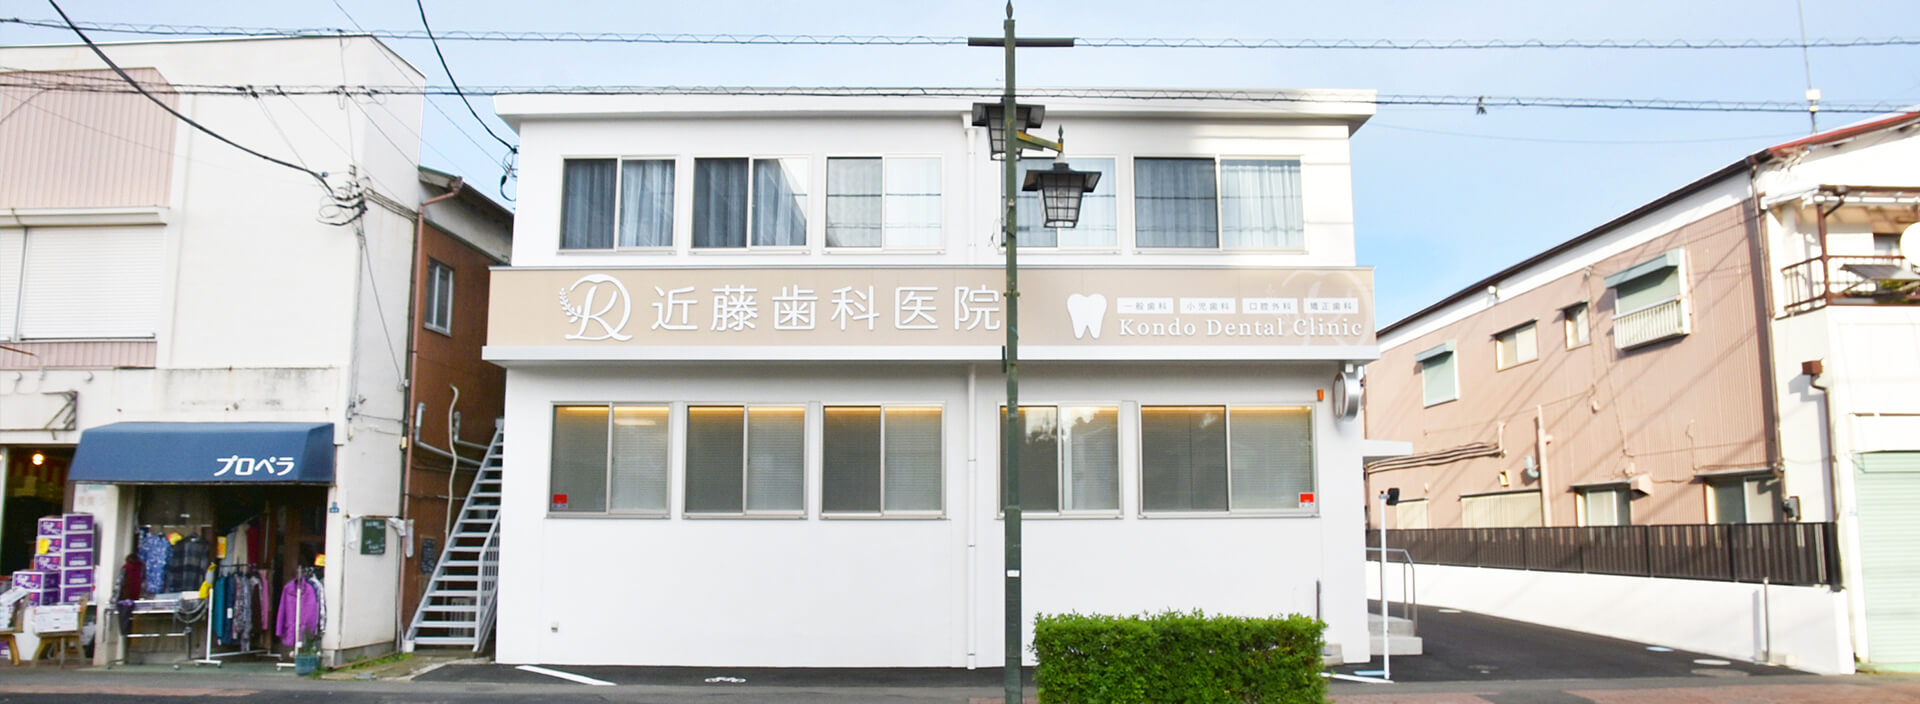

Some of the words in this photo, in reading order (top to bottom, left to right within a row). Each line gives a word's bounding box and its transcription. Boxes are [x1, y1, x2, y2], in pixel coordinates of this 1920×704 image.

[651, 284, 1001, 332] 近藤歯科医院
[1123, 302, 1167, 311] 一般歯科
[1186, 302, 1229, 311] 小児歯科
[1249, 302, 1292, 311] 口腔外科
[1310, 302, 1352, 311] 矯正歯科
[1119, 318, 1196, 336] Kondo
[1207, 318, 1283, 336] Dental
[1293, 317, 1362, 336] Clinic
[213, 454, 295, 477] プロペラ
